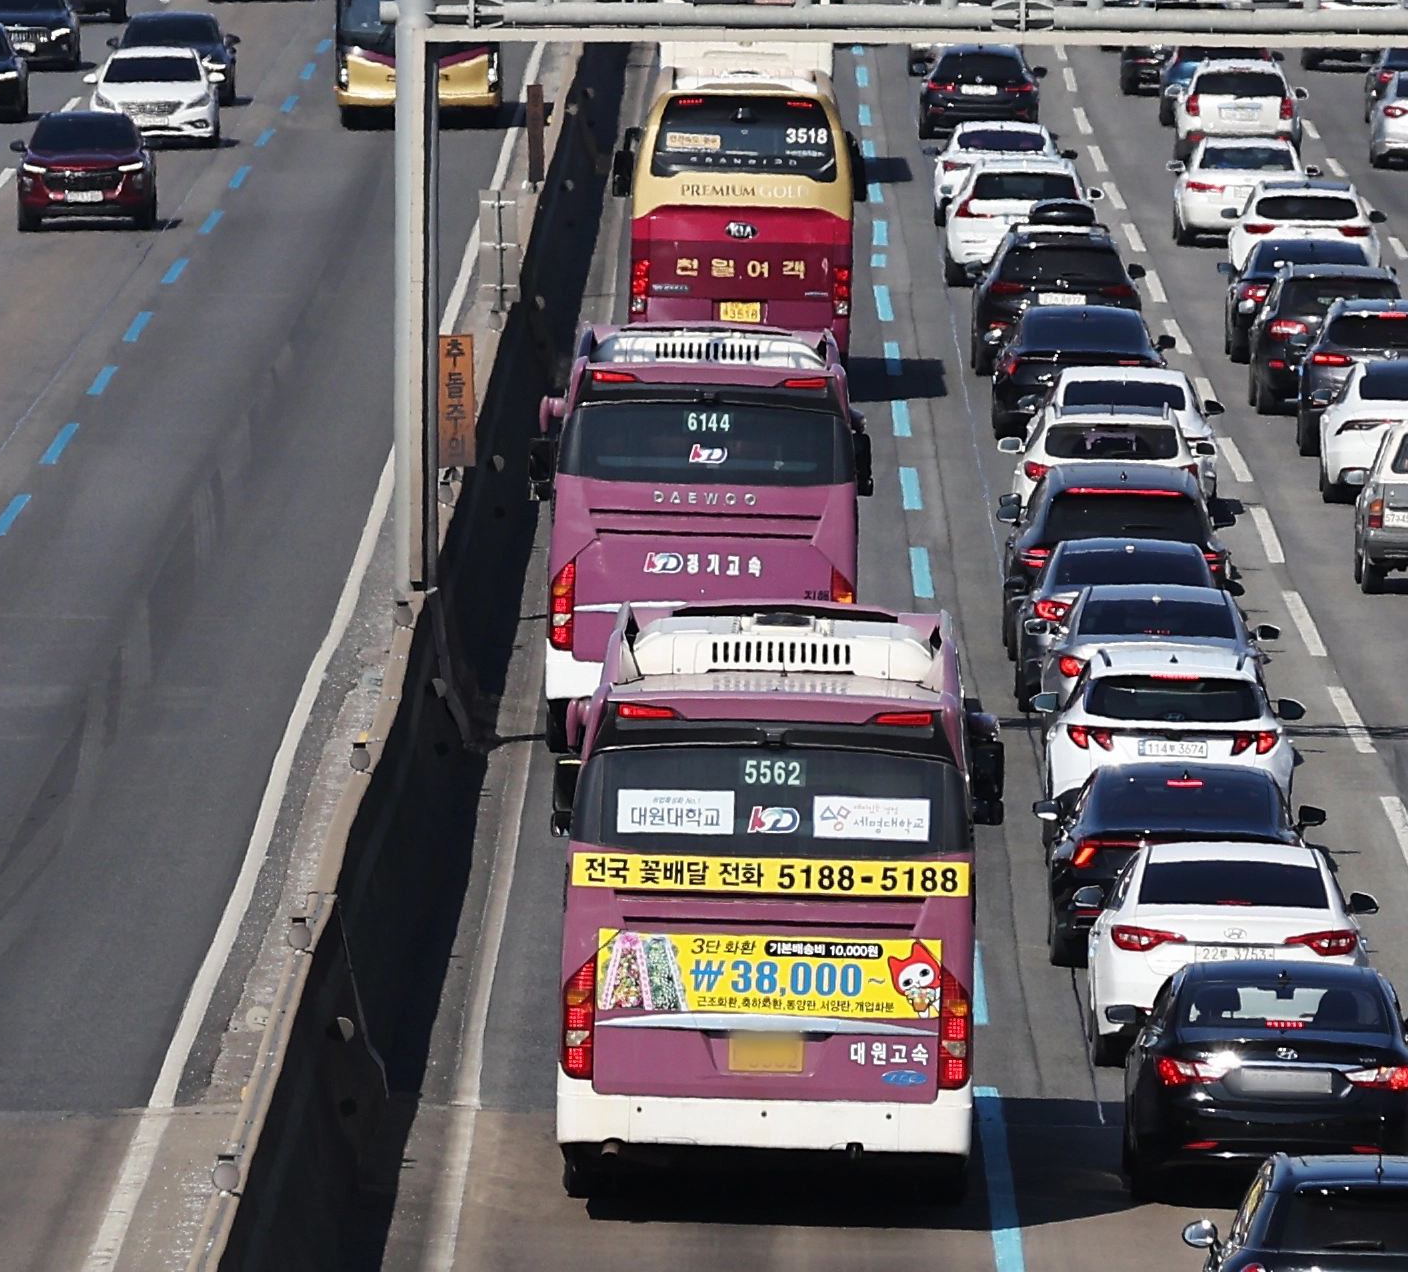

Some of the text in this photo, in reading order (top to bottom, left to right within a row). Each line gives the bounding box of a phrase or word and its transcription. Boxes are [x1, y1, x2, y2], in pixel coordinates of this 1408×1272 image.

[785, 128, 828, 144] 3518
[681, 184, 756, 197] PREMIUM
[730, 223, 754, 238] KIA
[675, 258, 807, 279] 천일여객
[687, 412, 731, 433] 6144
[653, 491, 757, 507] DAEWOO
[687, 553, 762, 578] 경기고속
[1178, 742, 1204, 755] 3674
[744, 761, 802, 786] 5562
[630, 806, 721, 828] 대원대학교
[852, 817, 925, 834] 세명대학교
[585, 858, 630, 885] 전국
[640, 859, 709, 887] 꽃배달
[719, 862, 764, 888] 전화
[690, 938, 879, 958] 3단 화환 기본배송비 10,000원
[850, 1041, 929, 1066] 대원고속
